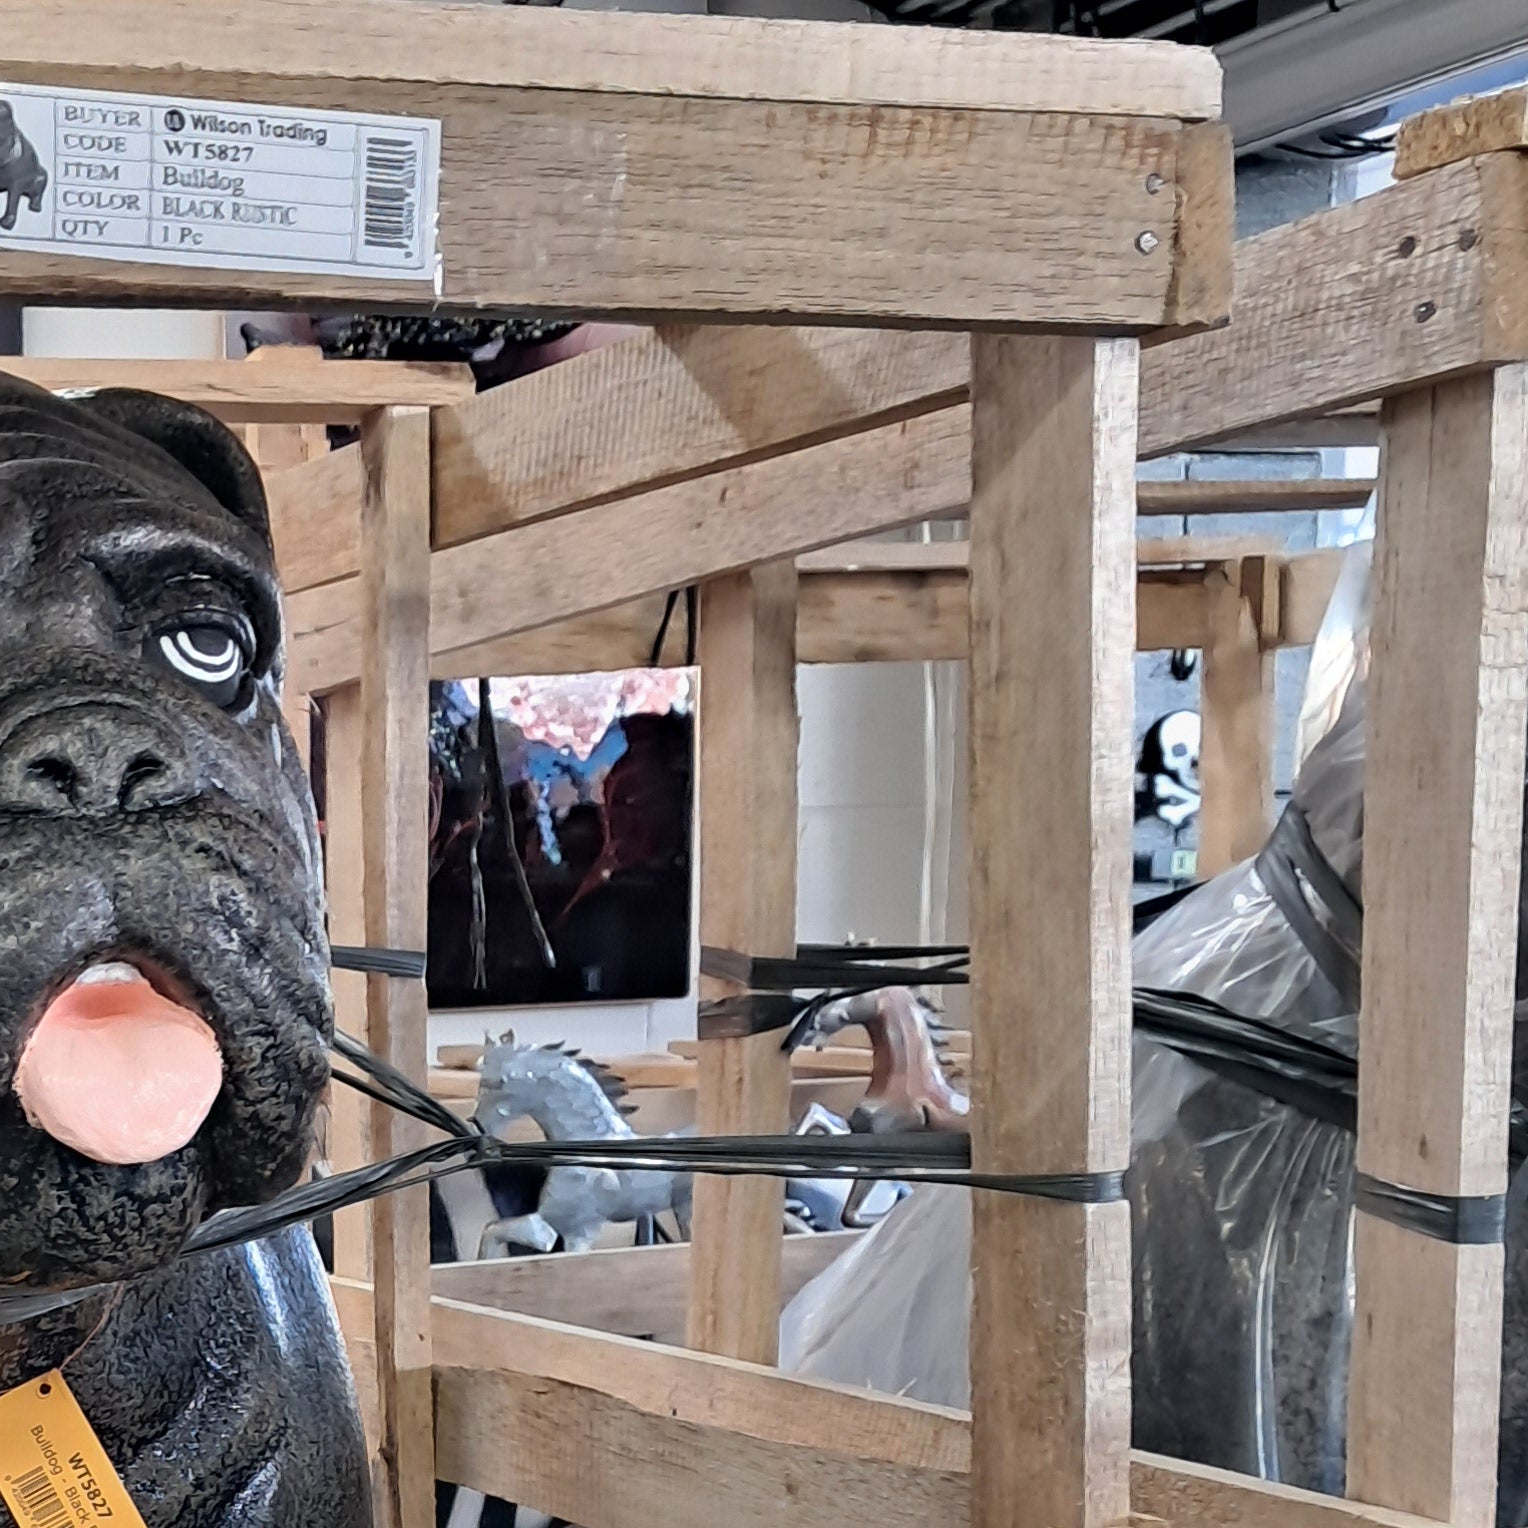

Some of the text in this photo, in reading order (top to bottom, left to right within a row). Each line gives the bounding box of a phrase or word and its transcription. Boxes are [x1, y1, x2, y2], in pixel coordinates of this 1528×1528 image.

[63, 105, 142, 127] BUYER
[190, 114, 328, 146] Wilson Trading
[63, 134, 127, 153] CODE
[163, 139, 254, 163] WT5827
[64, 162, 120, 181] ITEM
[162, 166, 245, 197] Bulldog
[62, 190, 141, 211] COLOR
[162, 196, 298, 226] BLACK RUSTIC
[61, 219, 109, 239] QTY
[179, 227, 203, 245] Pc
[30, 1424, 63, 1477] Bulldog
[64, 1486, 91, 1525] Black
[68, 1452, 113, 1519] WT5827
